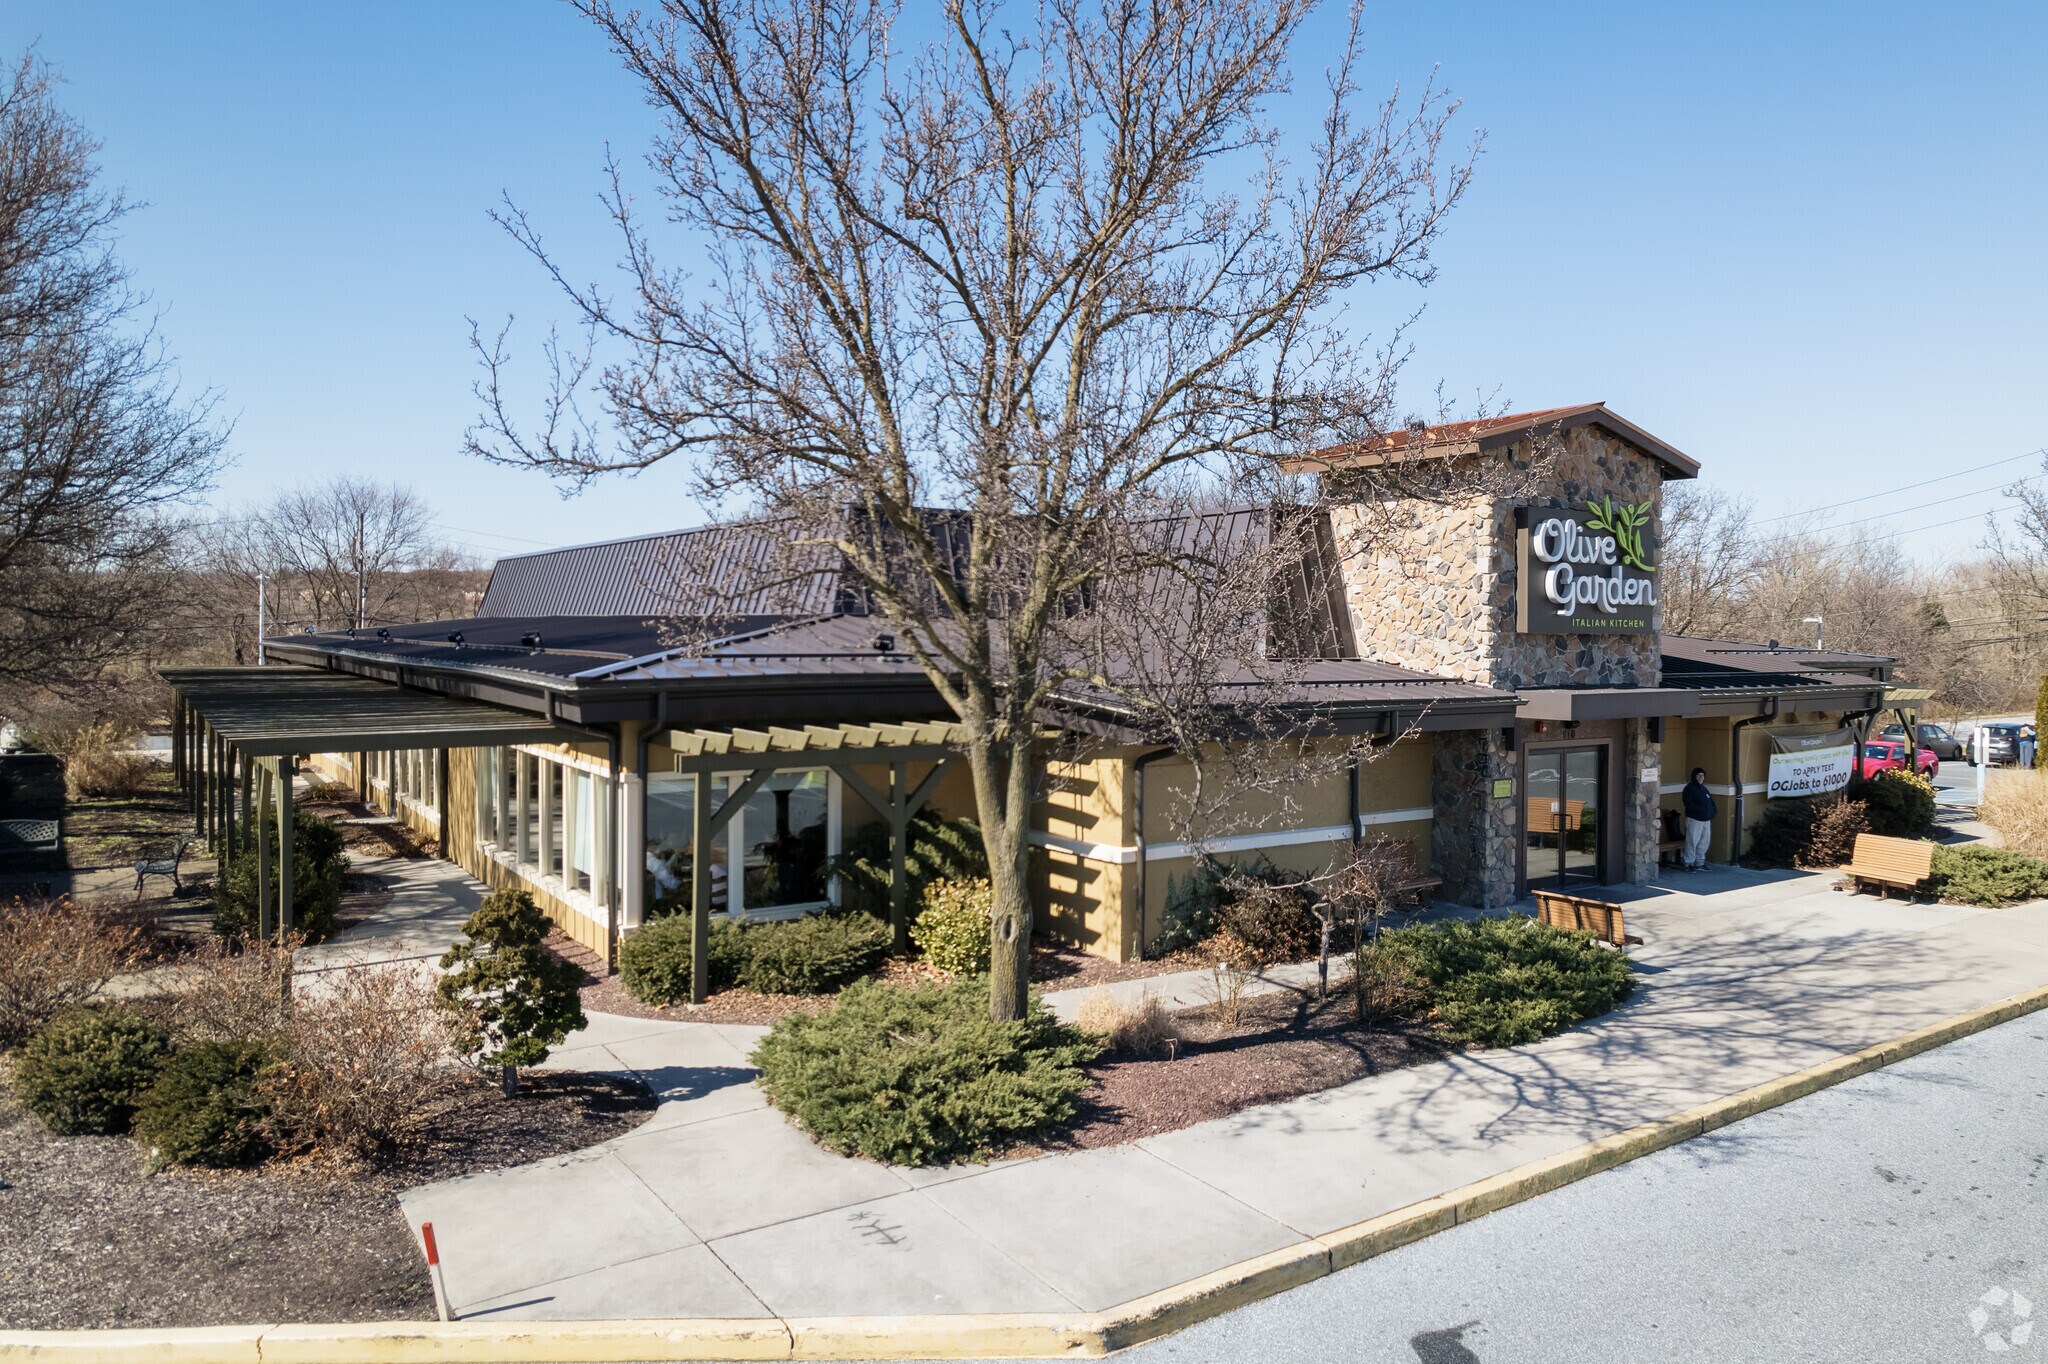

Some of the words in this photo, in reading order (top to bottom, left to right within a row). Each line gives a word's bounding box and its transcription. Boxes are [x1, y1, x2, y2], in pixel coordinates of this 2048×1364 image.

[1534, 518, 1617, 565] Olive
[1545, 562, 1657, 617] Garden
[1572, 618, 1606, 627] ITALIAN
[1609, 619, 1645, 628] KITCHEN
[1793, 768, 1802, 776] TO
[1803, 766, 1820, 777] APPLY
[1821, 763, 1835, 773] TEXT
[1771, 779, 1810, 791] OGJobs
[1812, 778, 1821, 788] to
[1823, 772, 1847, 787] 61000
